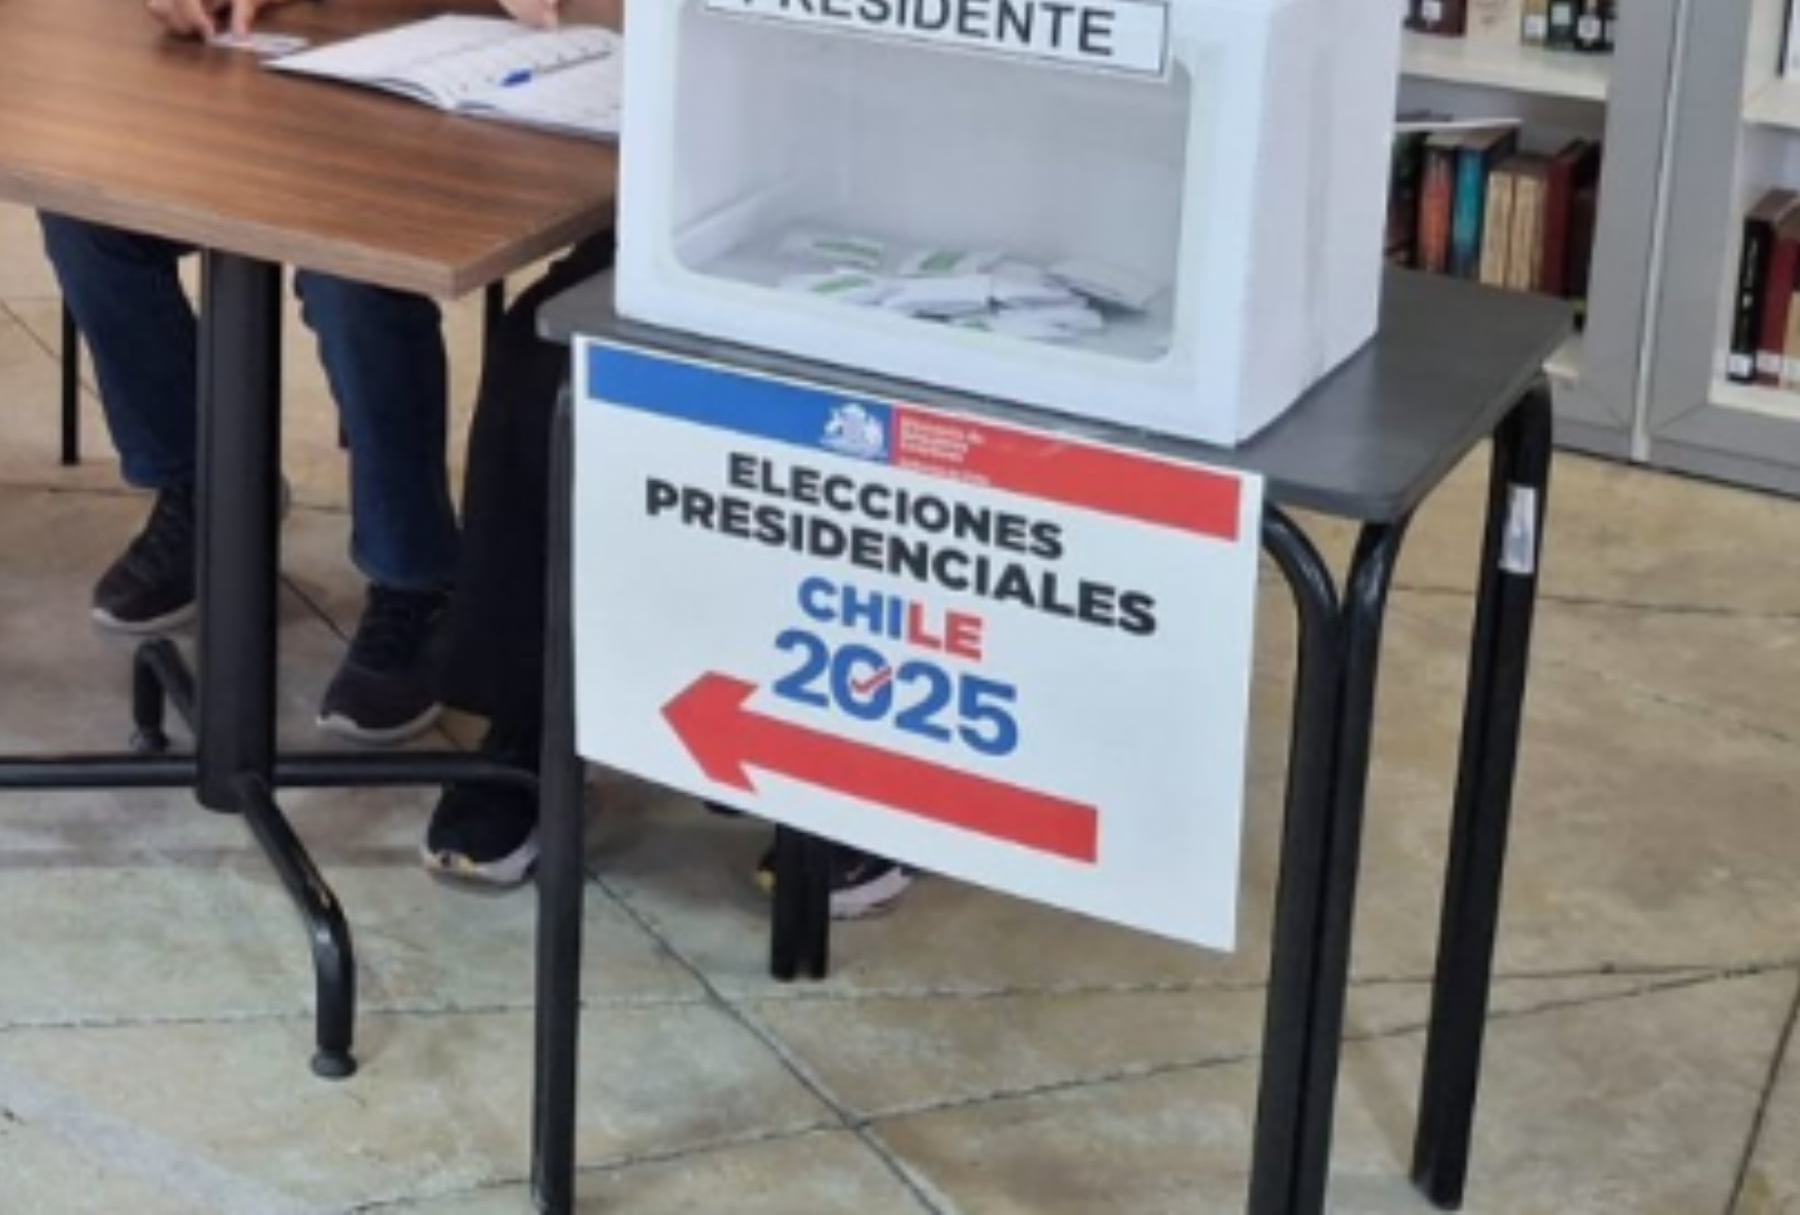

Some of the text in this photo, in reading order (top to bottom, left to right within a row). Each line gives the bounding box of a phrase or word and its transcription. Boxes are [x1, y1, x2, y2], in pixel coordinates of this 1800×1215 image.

[646, 478, 1158, 636] PRESIDENCIALES
[728, 452, 1063, 560] ELECCIONES
[798, 576, 984, 661] CHILE
[773, 628, 1019, 758] 2025
